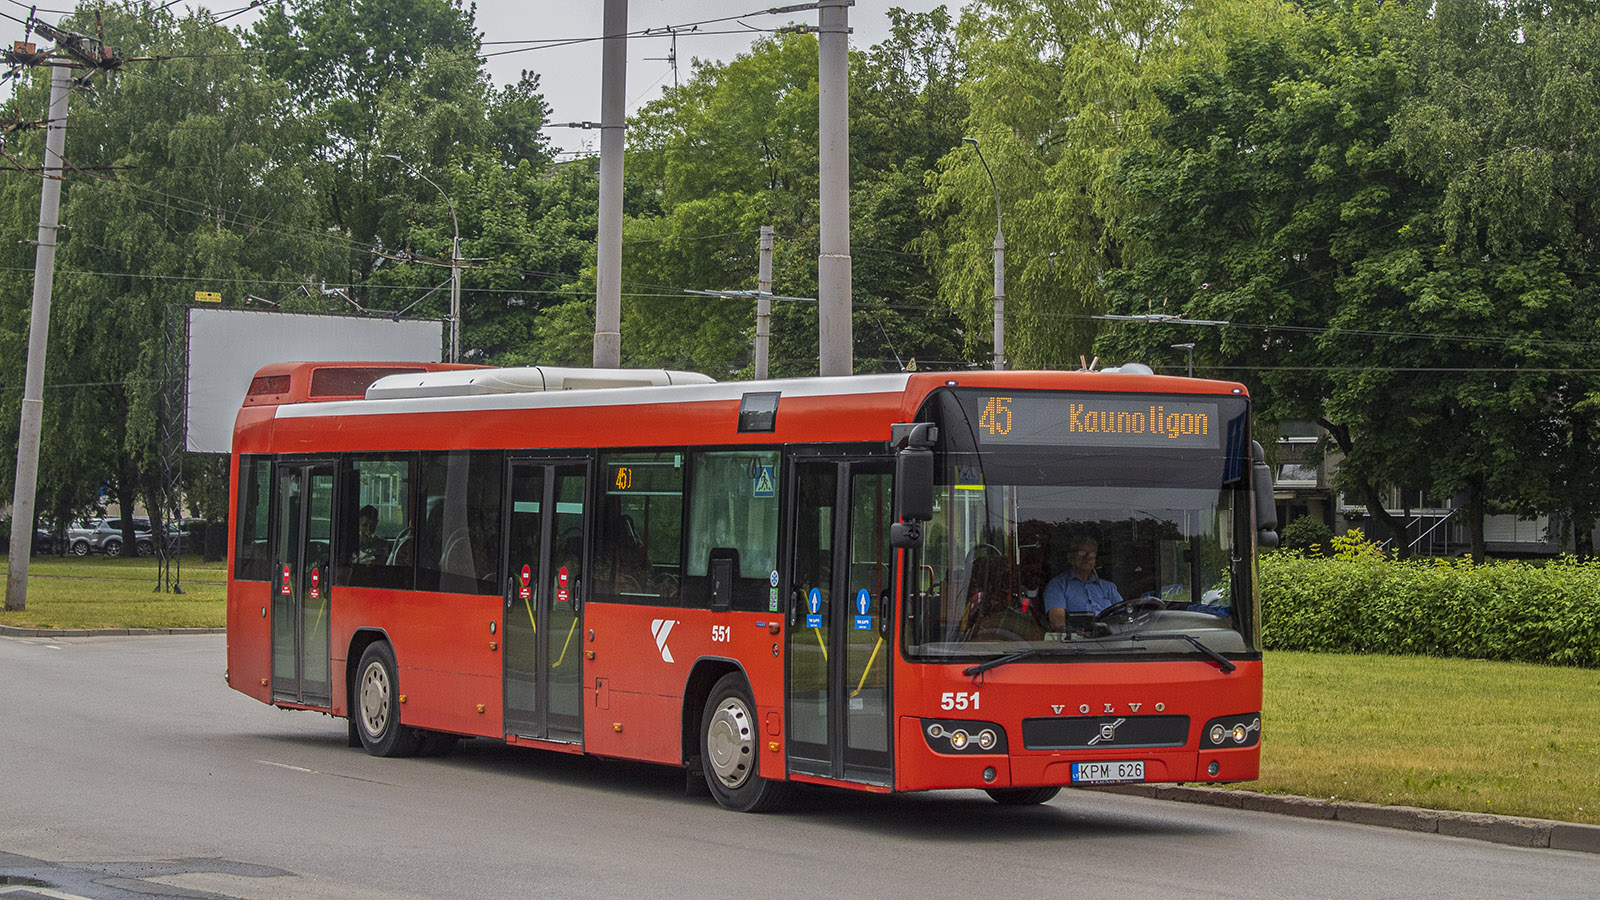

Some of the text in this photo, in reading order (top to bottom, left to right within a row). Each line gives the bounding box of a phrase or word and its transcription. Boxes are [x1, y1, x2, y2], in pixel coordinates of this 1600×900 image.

[978, 396, 1012, 436] 45
[1069, 403, 1208, 439] Kauno ligon
[711, 625, 731, 643] 551
[940, 691, 981, 711] 551
[1051, 702, 1166, 715] VOLVO
[1080, 763, 1142, 779] KPM 626
